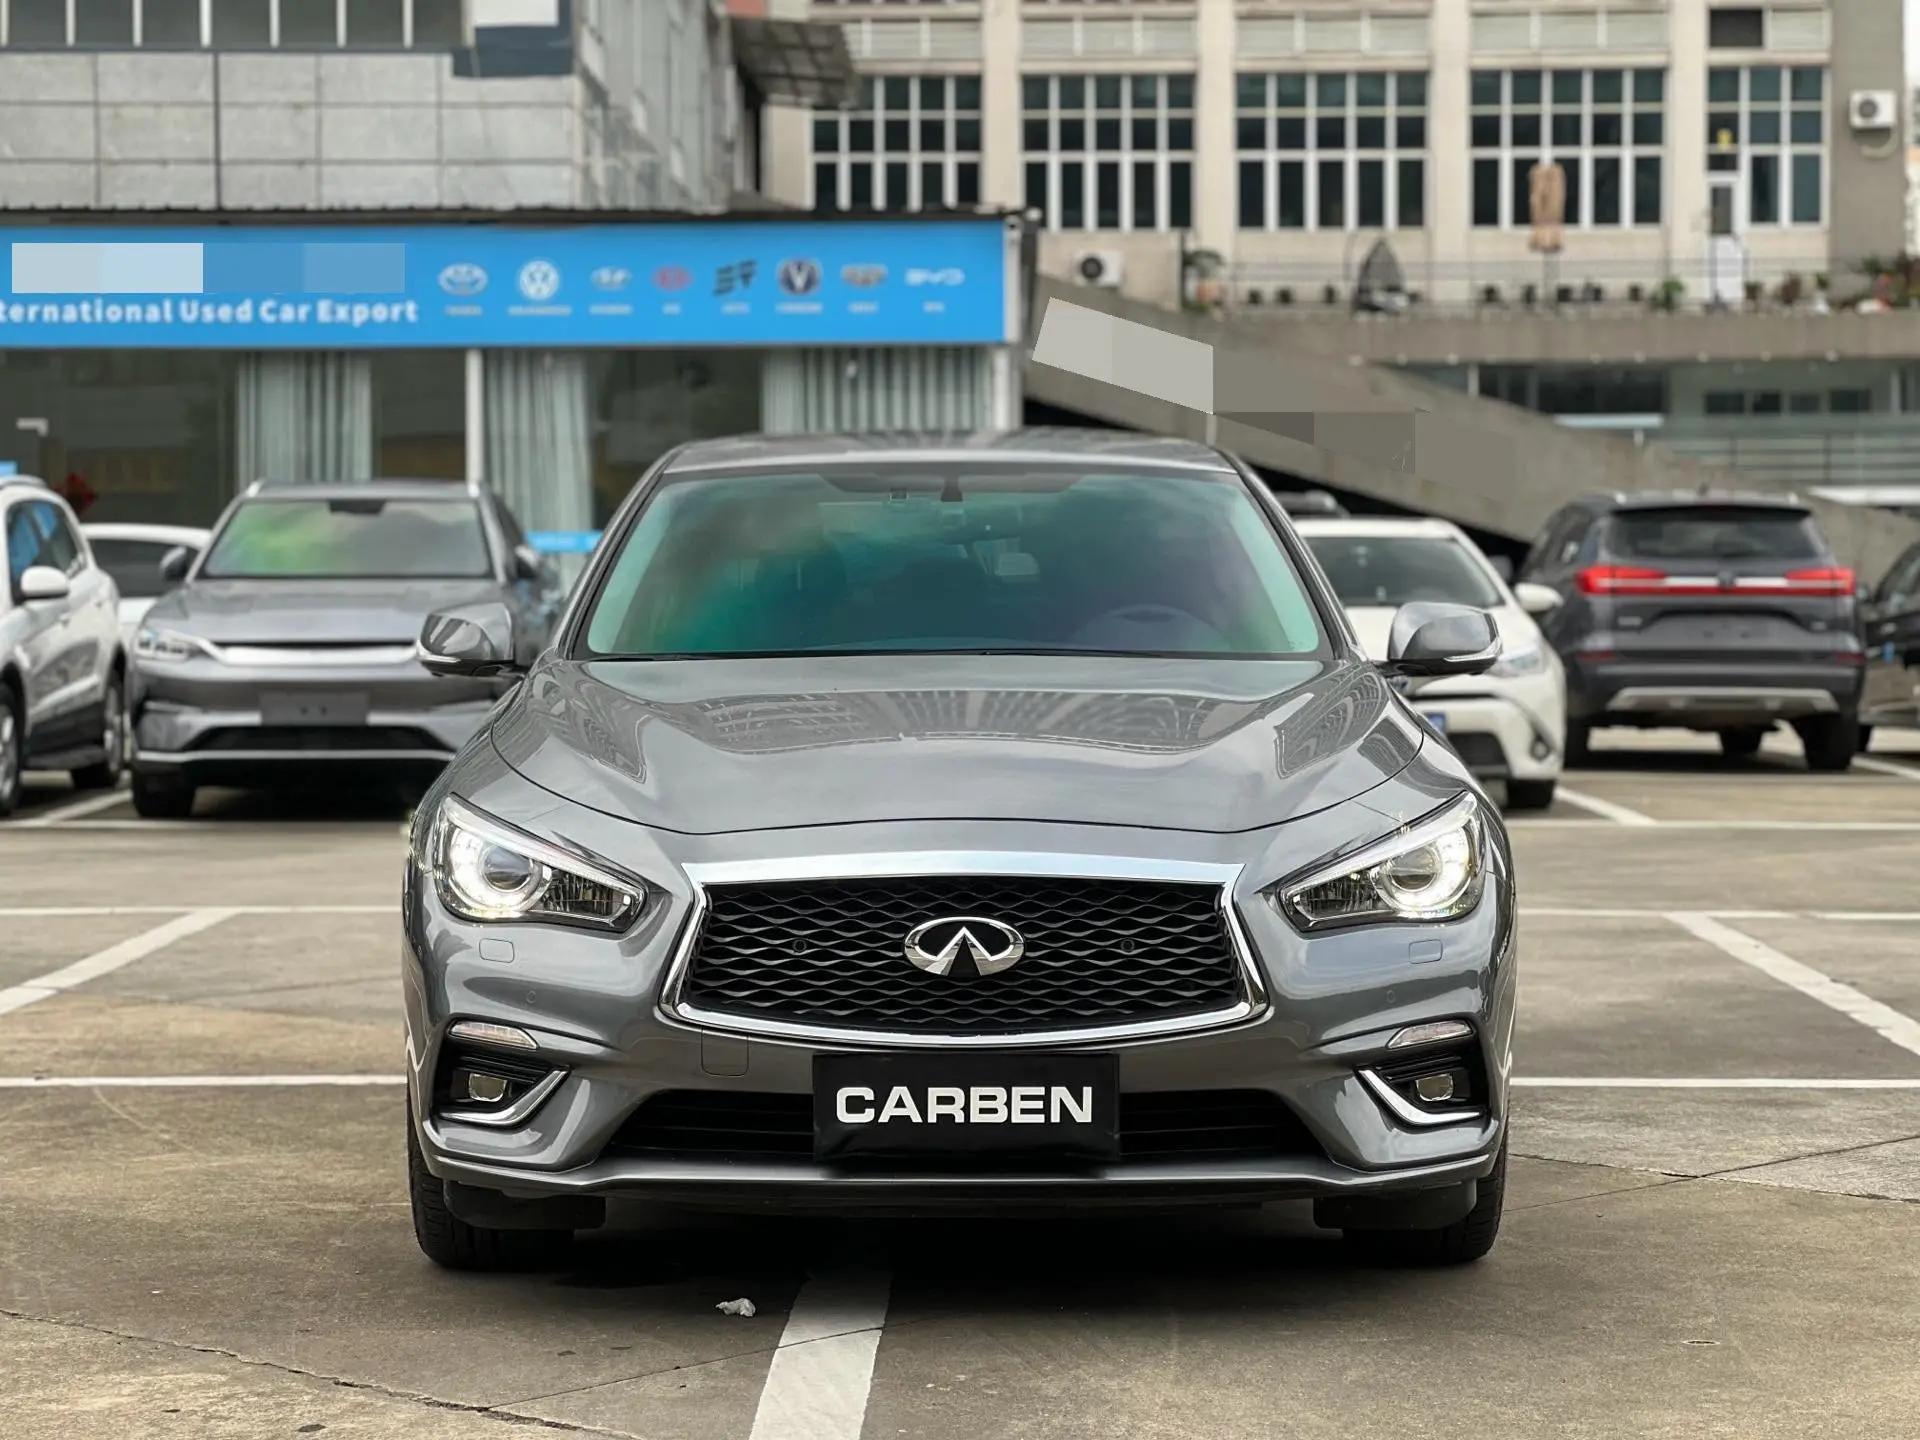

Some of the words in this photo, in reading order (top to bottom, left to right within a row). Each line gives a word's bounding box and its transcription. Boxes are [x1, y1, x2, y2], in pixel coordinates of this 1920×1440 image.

[179, 299, 253, 323] Used
[259, 300, 311, 323] Car
[316, 300, 418, 327] Export
[836, 1086, 1092, 1123] CARBEN
